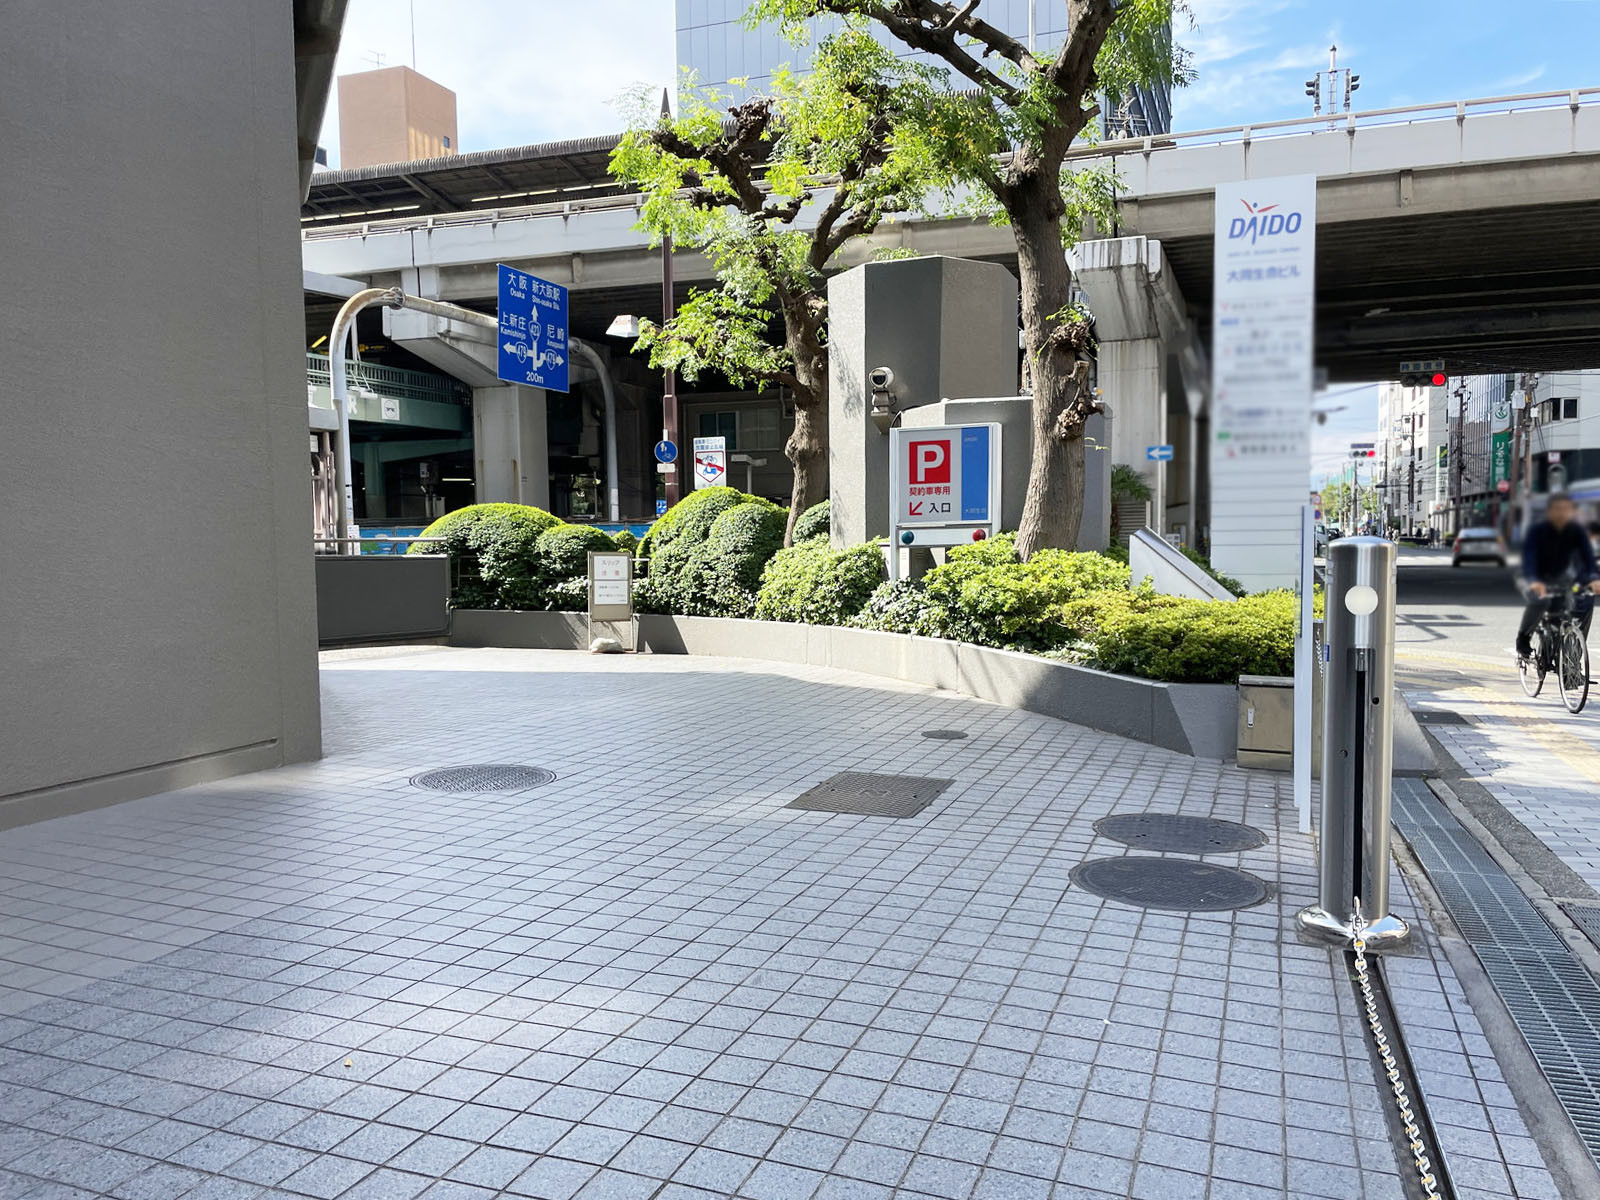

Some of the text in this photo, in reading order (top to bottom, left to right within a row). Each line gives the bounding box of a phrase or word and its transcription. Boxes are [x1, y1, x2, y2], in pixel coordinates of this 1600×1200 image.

[1227, 212, 1302, 246] DAIDO
[507, 272, 561, 302] 大阪 新大阪駅
[510, 287, 526, 300] Osaka
[500, 311, 527, 331] 上新庄
[546, 324, 565, 341] 尼崎
[526, 371, 544, 384] 200m
[916, 444, 945, 483] P
[909, 486, 951, 497] 契約車専用
[928, 502, 951, 515] 入口
